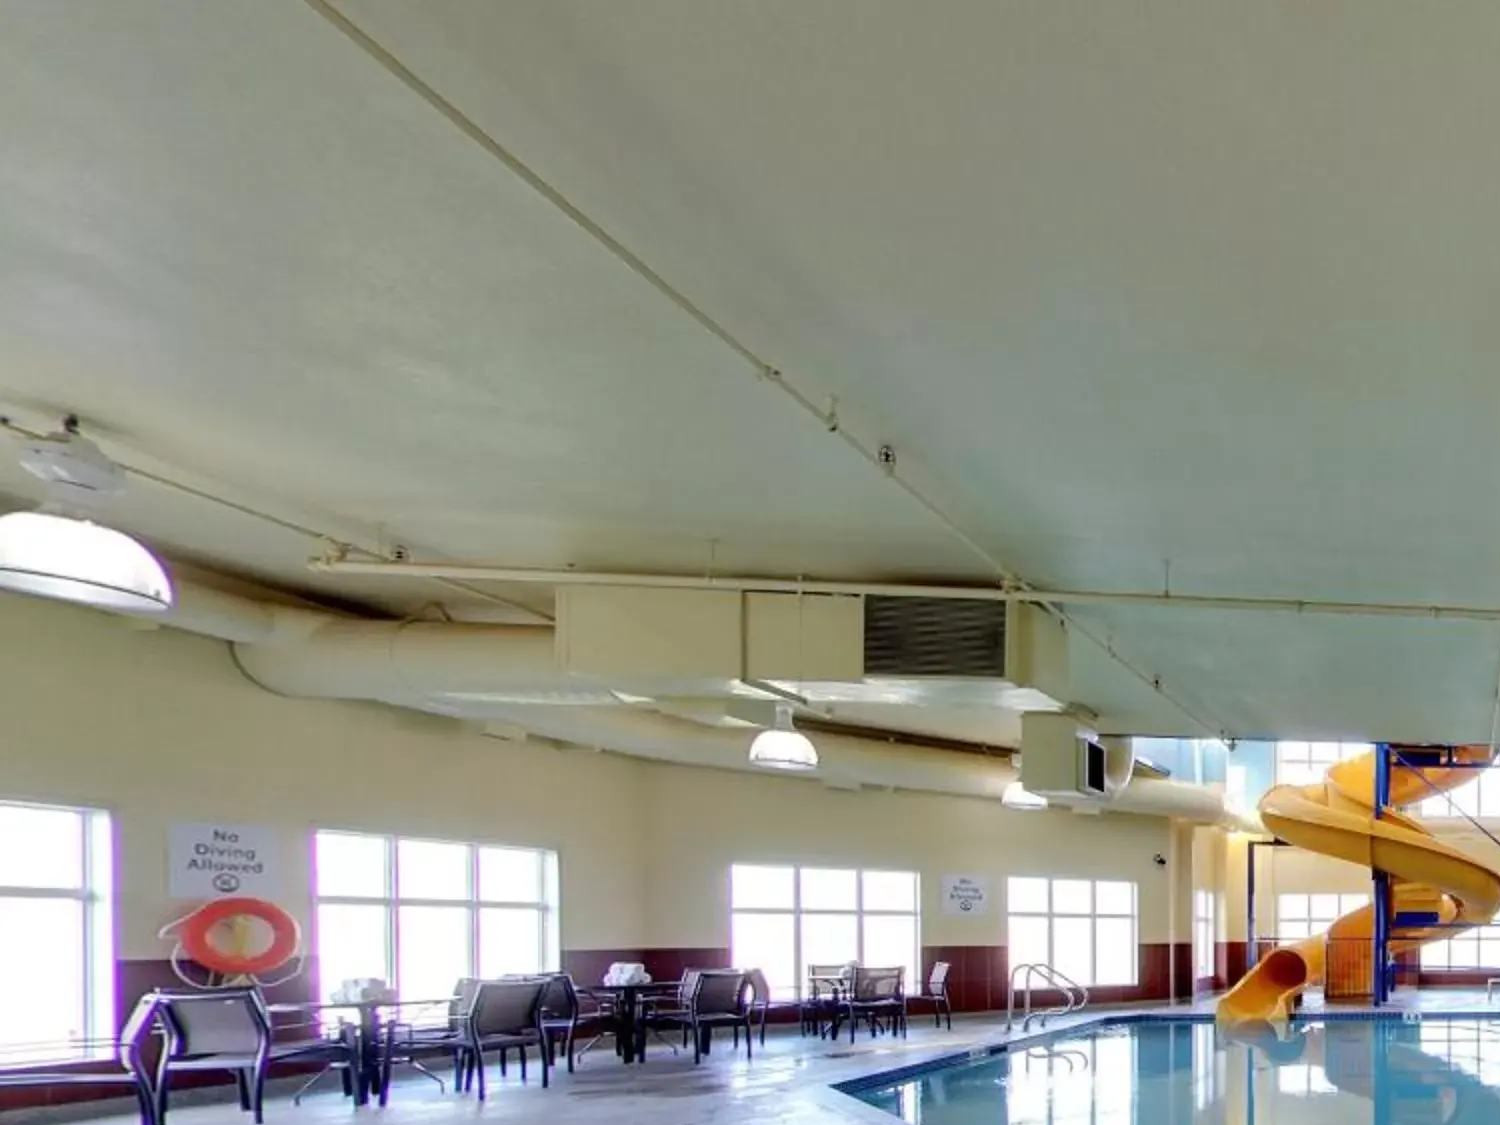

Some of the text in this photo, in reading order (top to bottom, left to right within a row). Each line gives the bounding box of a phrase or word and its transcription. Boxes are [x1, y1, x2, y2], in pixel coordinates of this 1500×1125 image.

[213, 829, 239, 843] No
[194, 843, 256, 861] Diving
[187, 859, 264, 874] Allowed
